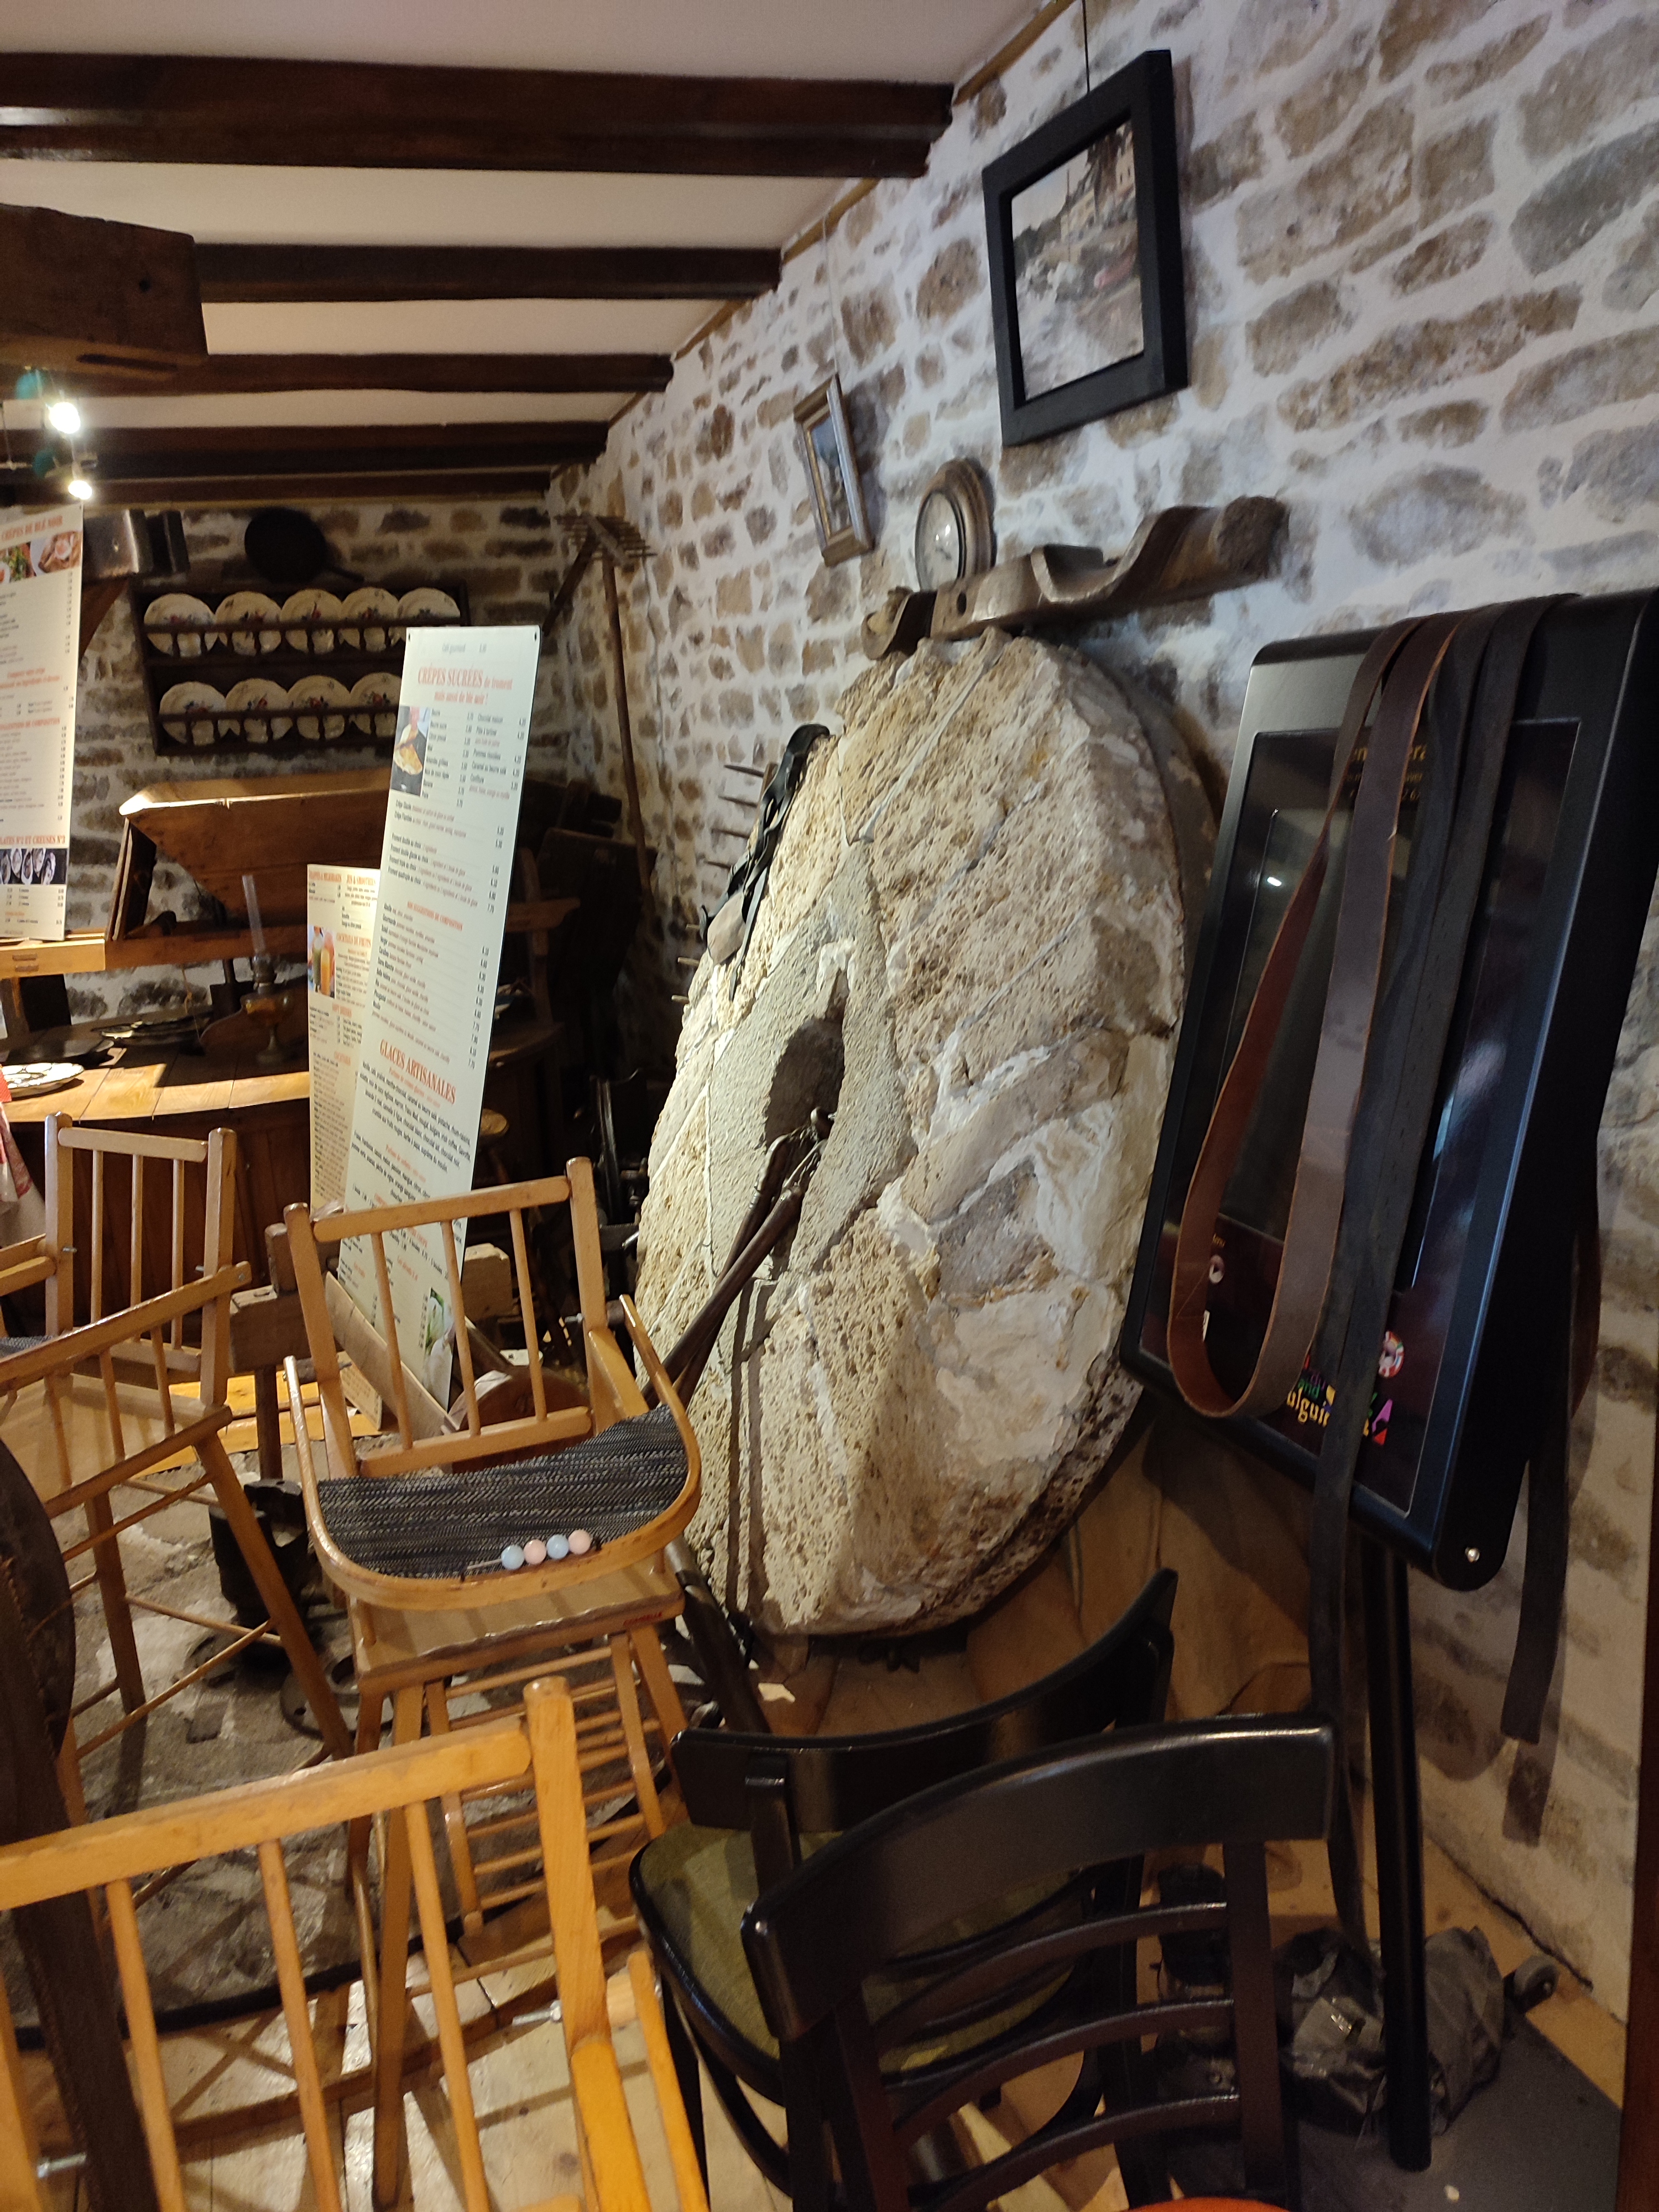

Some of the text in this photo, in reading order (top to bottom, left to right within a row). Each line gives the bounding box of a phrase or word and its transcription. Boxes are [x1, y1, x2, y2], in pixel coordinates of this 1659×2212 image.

[418, 662, 446, 686] CRÊPES
[447, 665, 483, 689] SUCRÉES
[380, 1039, 405, 1070] GLACES
[406, 1057, 456, 1105] ARTISANALES
